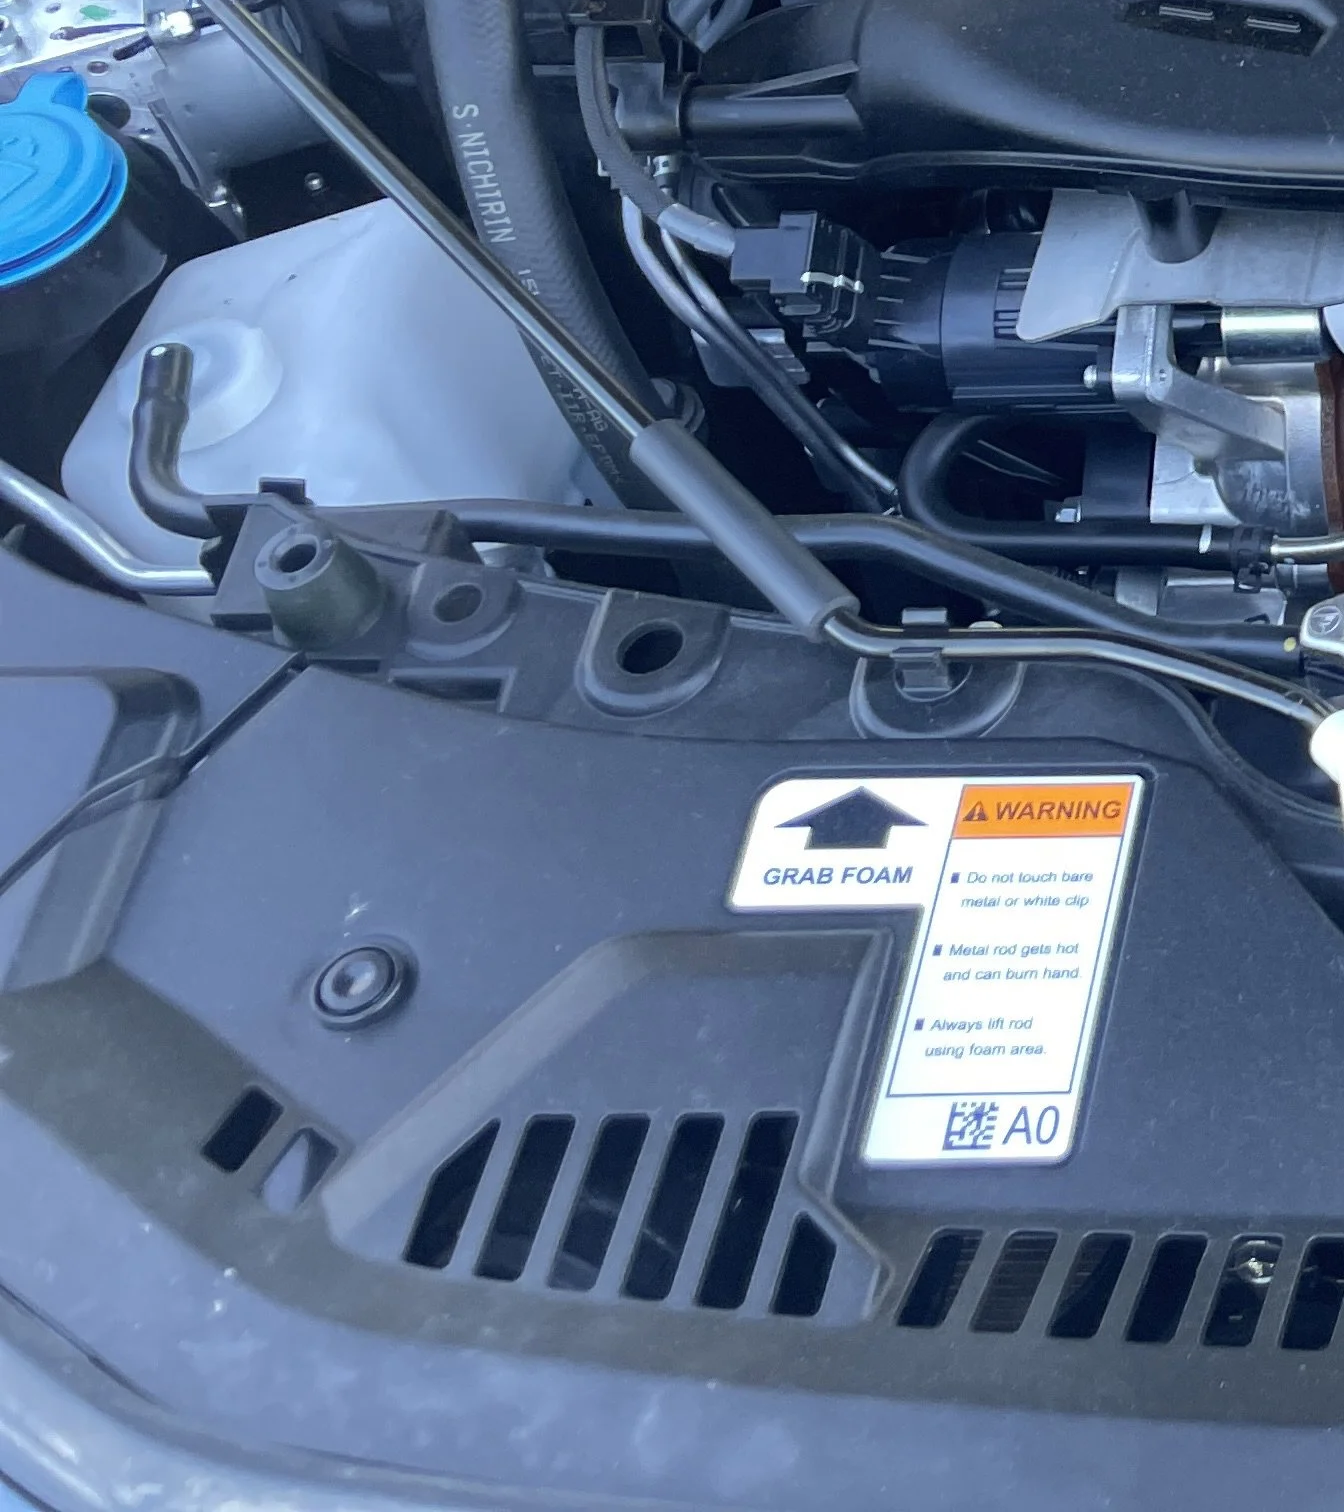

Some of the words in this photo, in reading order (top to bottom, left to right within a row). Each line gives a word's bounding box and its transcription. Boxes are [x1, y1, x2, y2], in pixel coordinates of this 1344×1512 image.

[995, 800, 1122, 823] WARNING
[763, 867, 834, 886] GRAB
[840, 866, 913, 885] FOAM
[966, 871, 987, 884] Do
[991, 871, 1014, 884] not
[1018, 871, 1057, 884] touch
[1061, 870, 1094, 884] bare
[960, 894, 1000, 908] metal
[1004, 896, 1020, 908] or
[1023, 894, 1060, 908] white
[1064, 894, 1090, 910] clip
[949, 943, 989, 957] Metal
[992, 942, 1016, 956] rod
[1020, 943, 1051, 959] gets
[1055, 942, 1080, 955] hot
[943, 968, 971, 981] and
[975, 969, 1002, 981] can
[1005, 967, 1039, 980] burn
[930, 1017, 983, 1034] Always
[987, 1017, 1005, 1030] lift
[1008, 1016, 1033, 1030] rod
[924, 1043, 964, 1059] using
[968, 1042, 1005, 1057] foam
